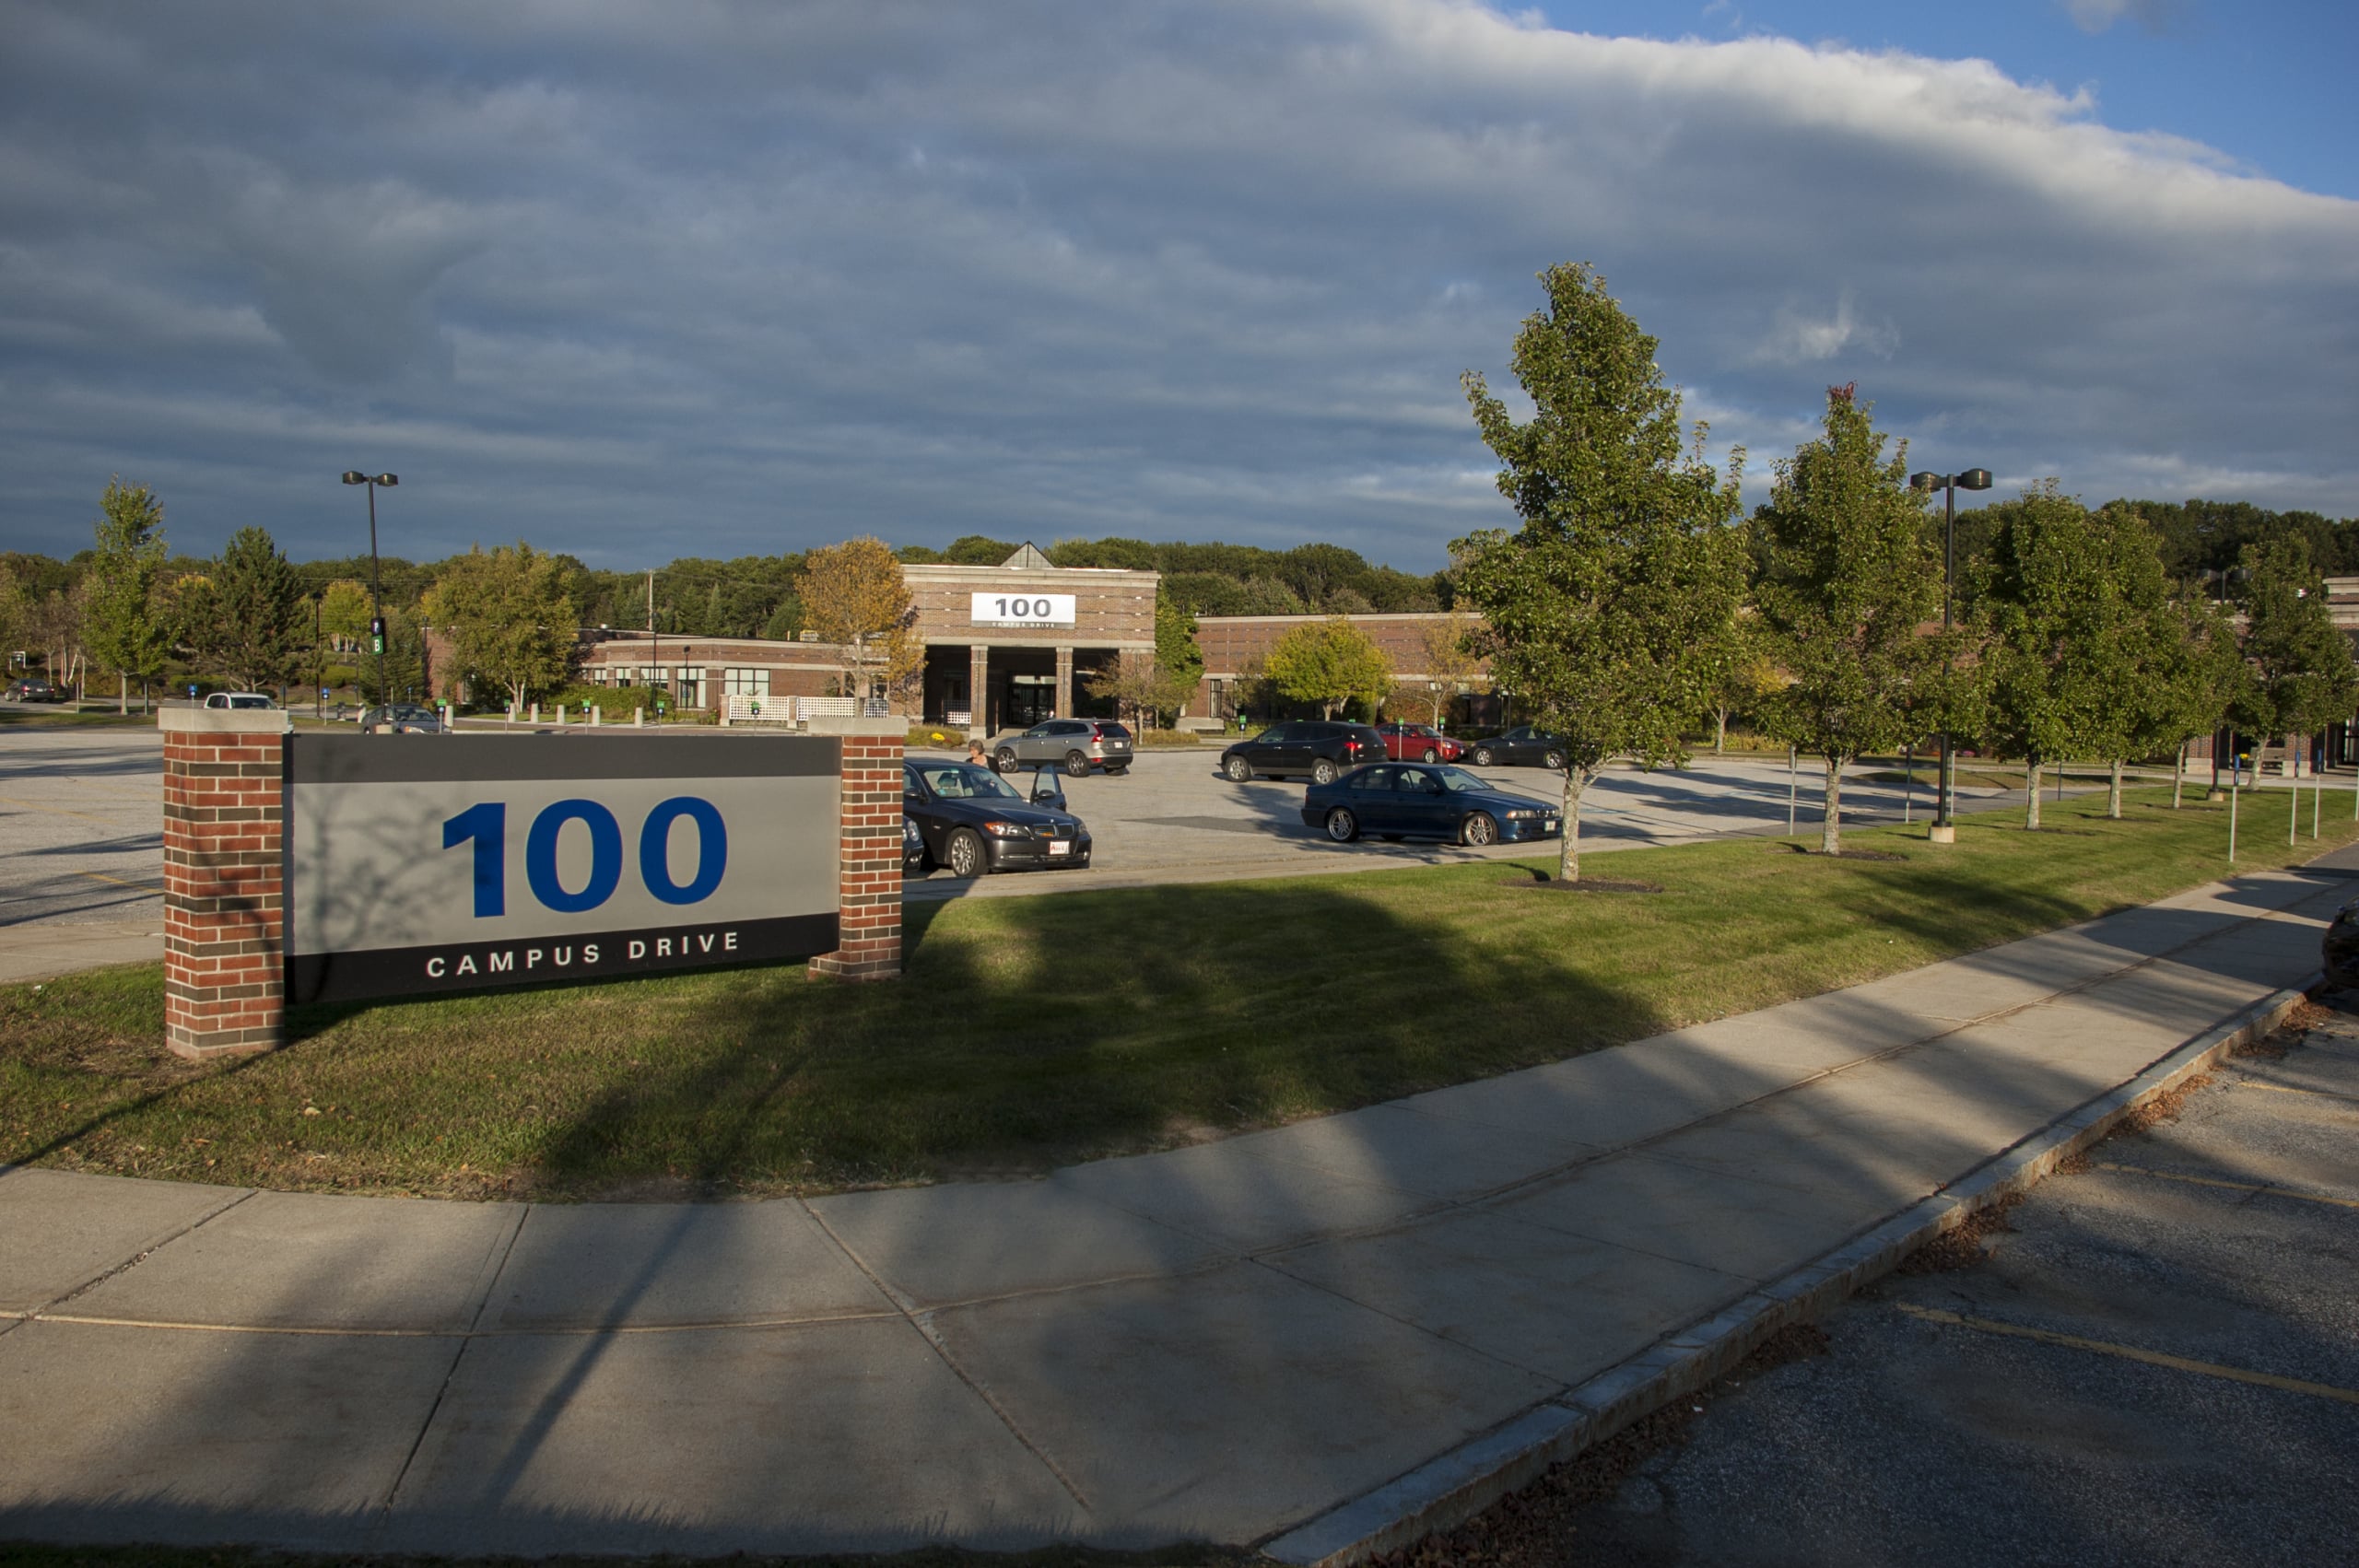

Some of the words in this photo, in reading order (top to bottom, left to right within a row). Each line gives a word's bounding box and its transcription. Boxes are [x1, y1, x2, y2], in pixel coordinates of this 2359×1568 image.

[995, 598, 1051, 617] 100
[374, 638, 381, 652] B
[442, 796, 728, 919] 100
[427, 944, 600, 977] CAMPUS
[628, 931, 738, 960] DRIVE
